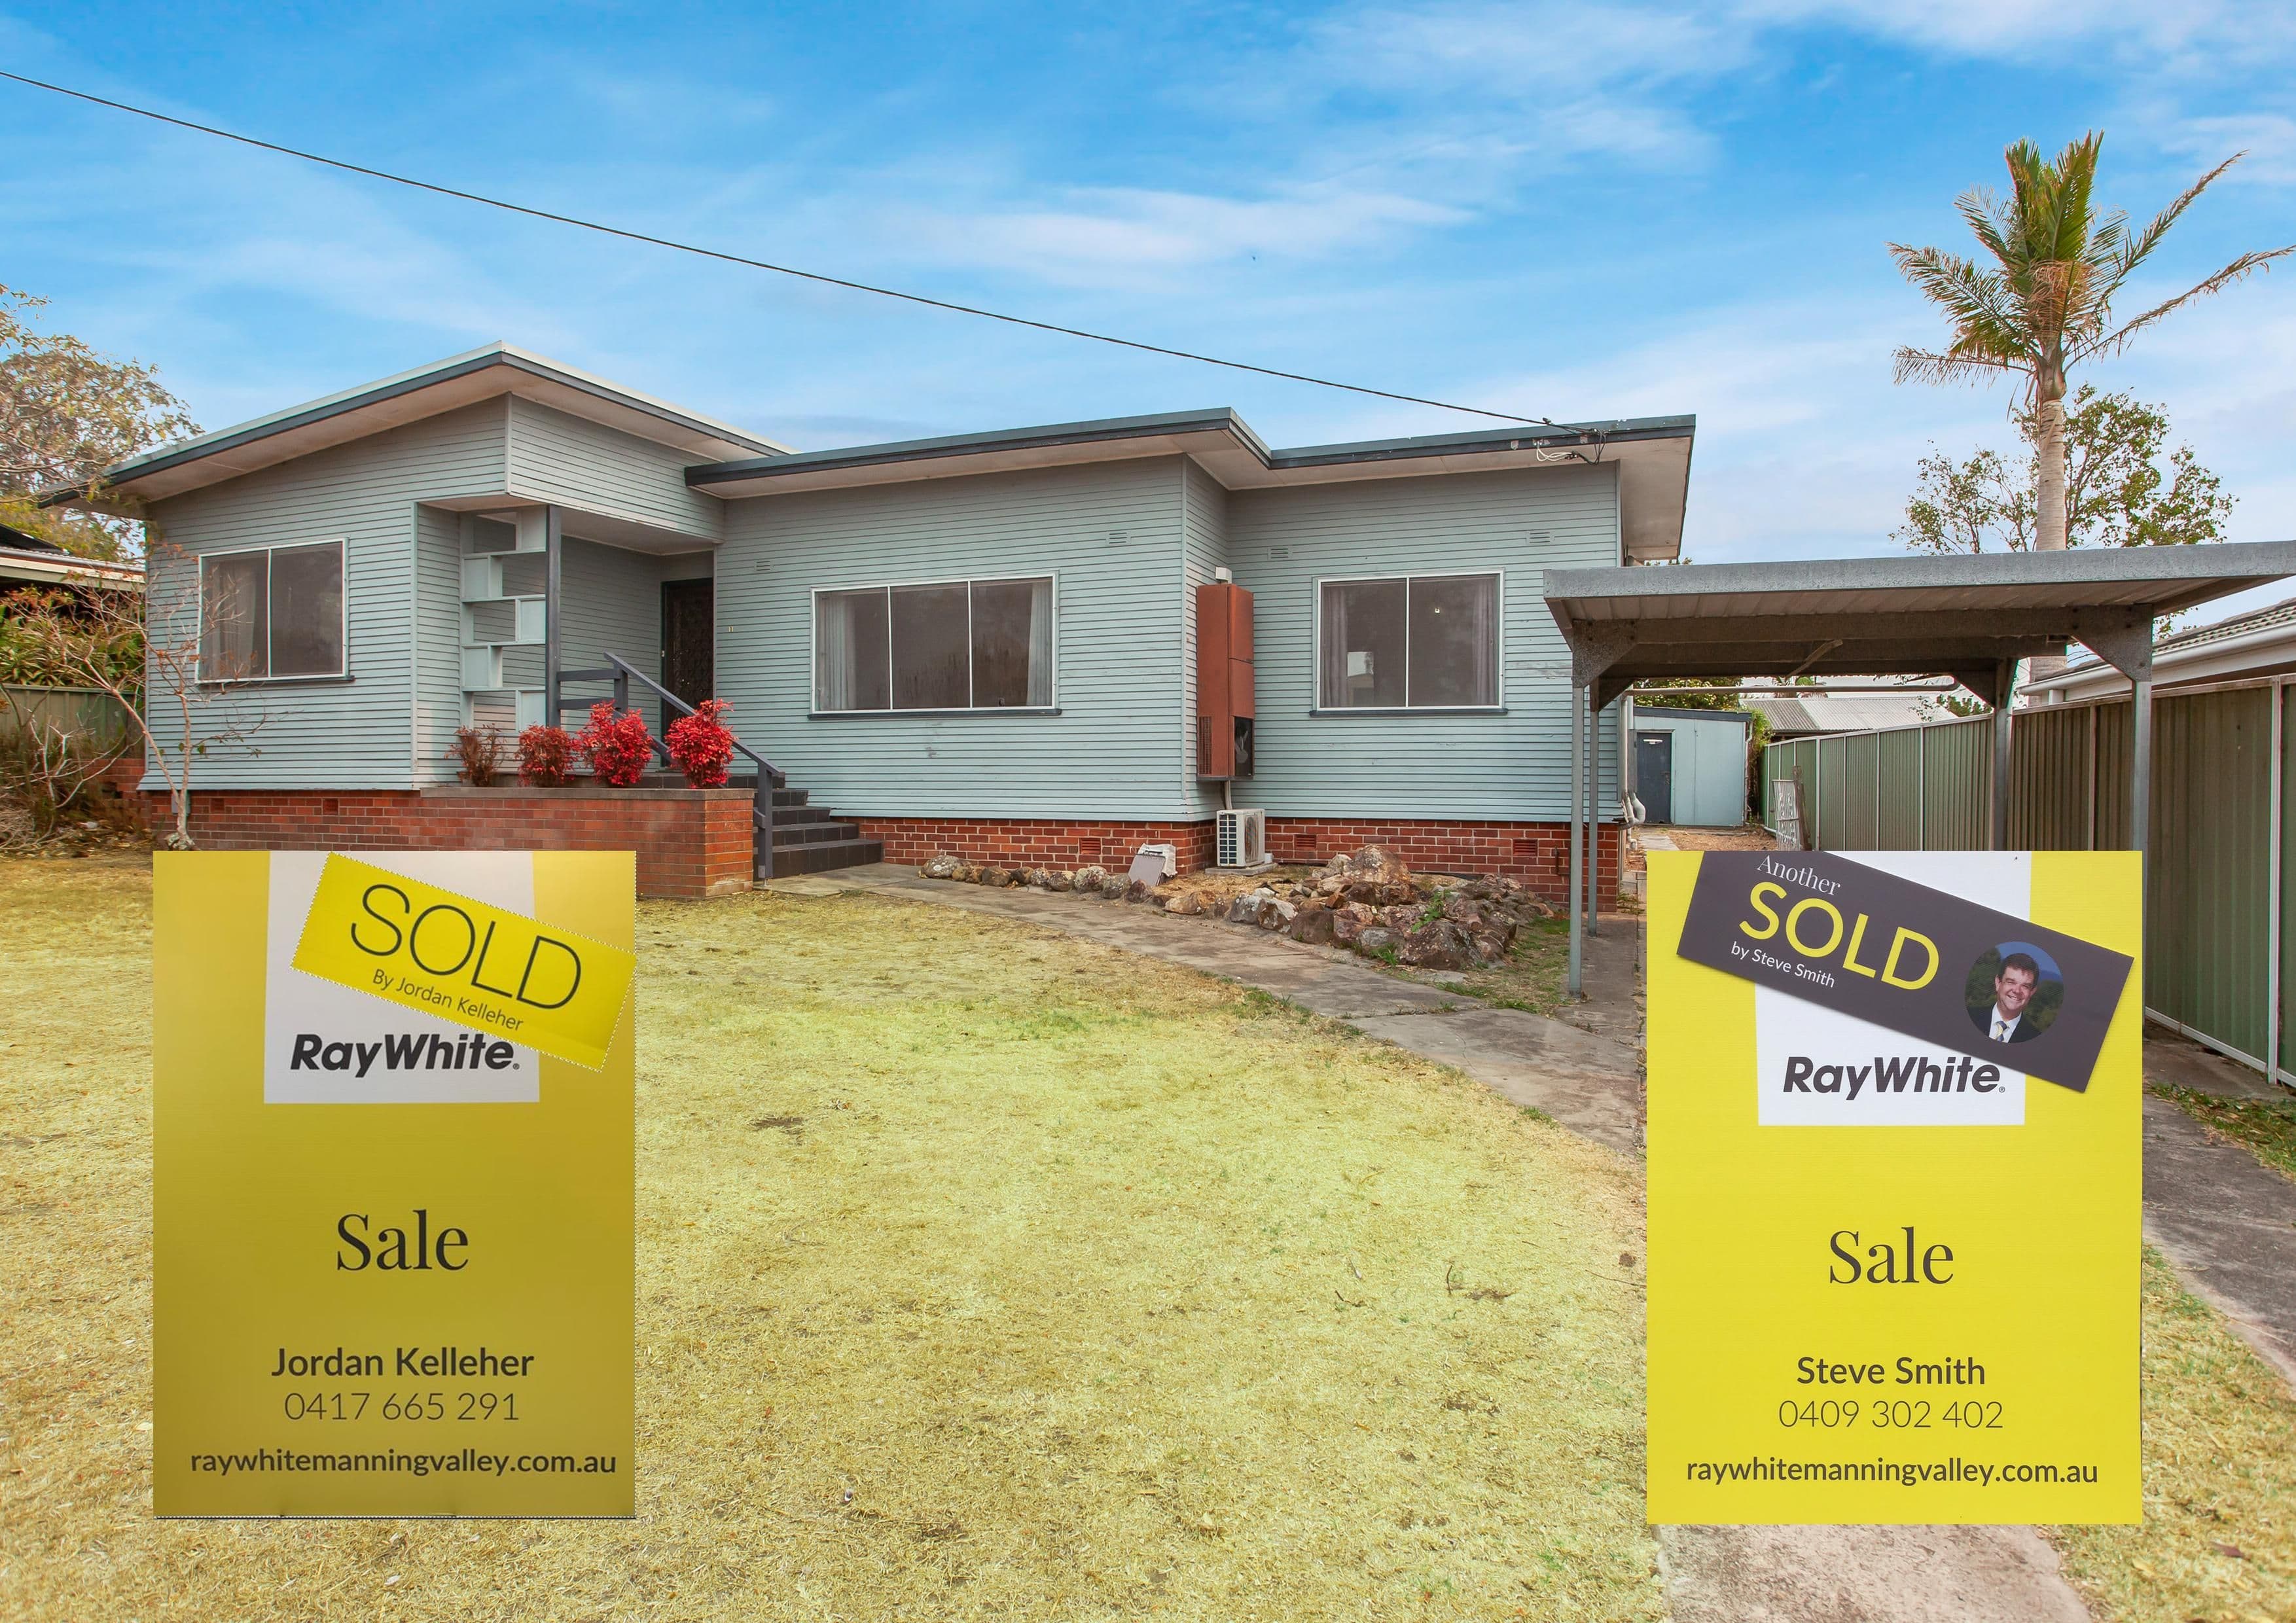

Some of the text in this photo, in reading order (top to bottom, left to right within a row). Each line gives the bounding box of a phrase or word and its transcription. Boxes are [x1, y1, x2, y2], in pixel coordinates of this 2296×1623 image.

[1757, 855, 1840, 896] Another
[350, 884, 581, 1009] SOLD
[1739, 882, 1939, 990] SOLD
[1731, 941, 1835, 988] by Steve Smith
[372, 969, 524, 1031] By Jordan Kelleher
[337, 1209, 469, 1271] Sale
[1829, 1226, 1954, 1284] Sale
[272, 1347, 534, 1376] Jordan Kelleher
[1797, 1357, 1985, 1385] Steve Smith
[285, 1393, 519, 1420] 0417 665 291
[1779, 1400, 2003, 1429] 0409 302 402
[191, 1448, 616, 1476] raywhitemanningvalley.com.au
[1687, 1456, 2098, 1487] raywhitemanningvalley.com.au
